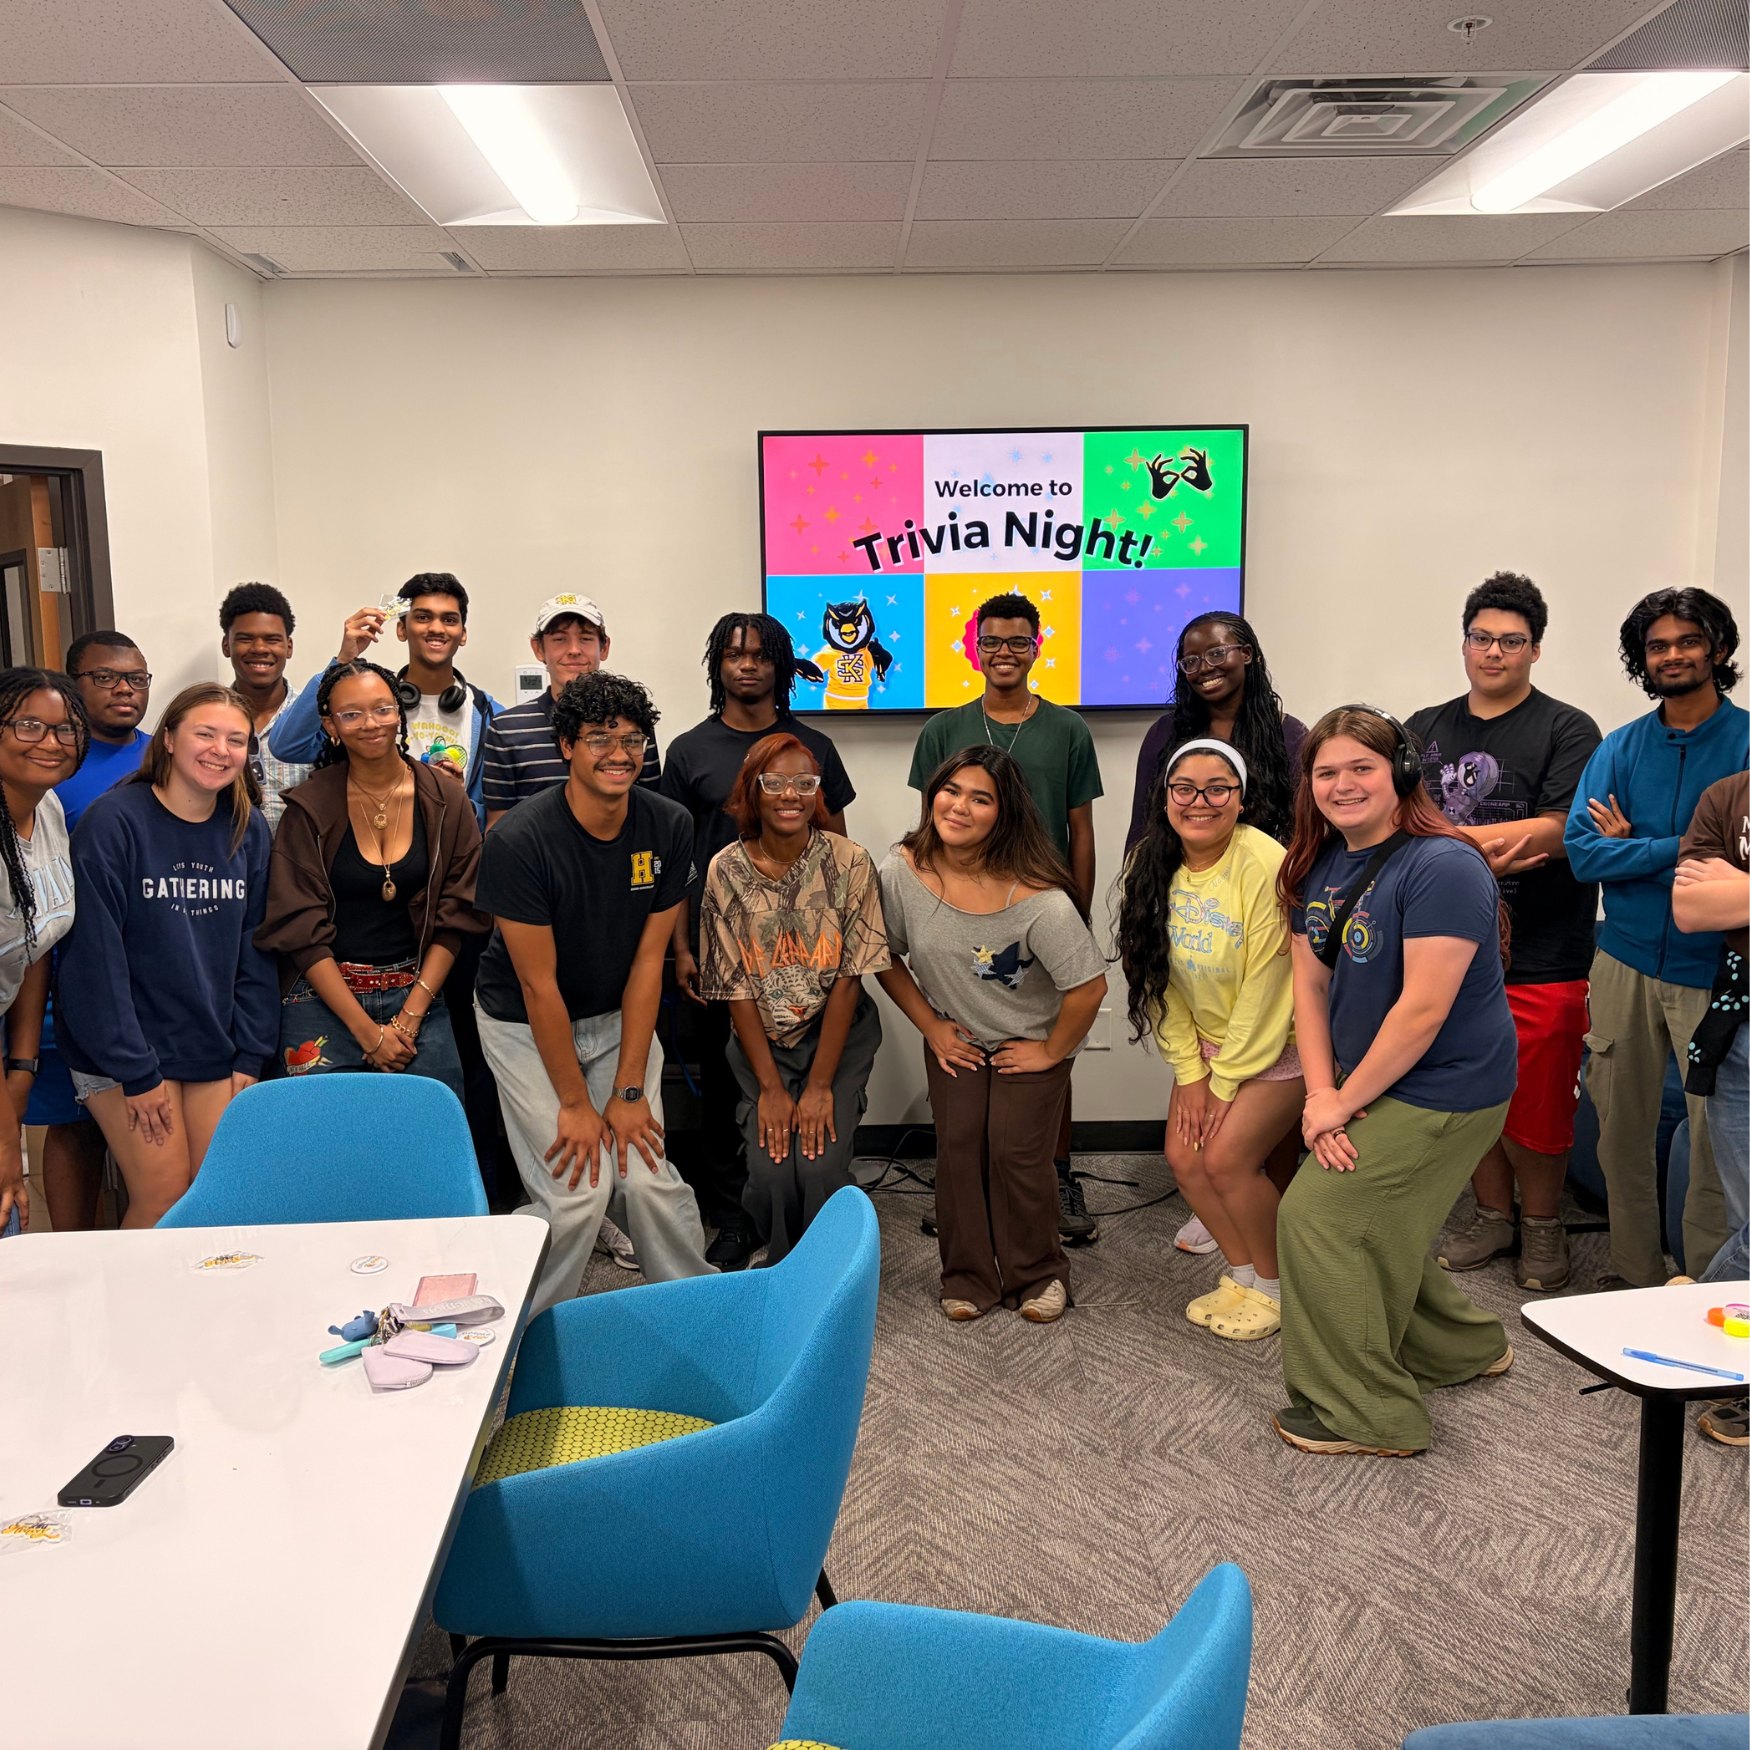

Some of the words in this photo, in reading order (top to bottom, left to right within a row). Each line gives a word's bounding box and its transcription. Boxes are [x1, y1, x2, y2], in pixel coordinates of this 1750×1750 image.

[935, 480, 1043, 498] Welcome
[1049, 480, 1073, 496] to
[853, 511, 990, 571] Trivia
[1004, 509, 1153, 569] Night!
[191, 862, 214, 873] YOUTH
[631, 850, 655, 886] H
[142, 877, 245, 899] GATHERING
[191, 904, 219, 916] THINGS
